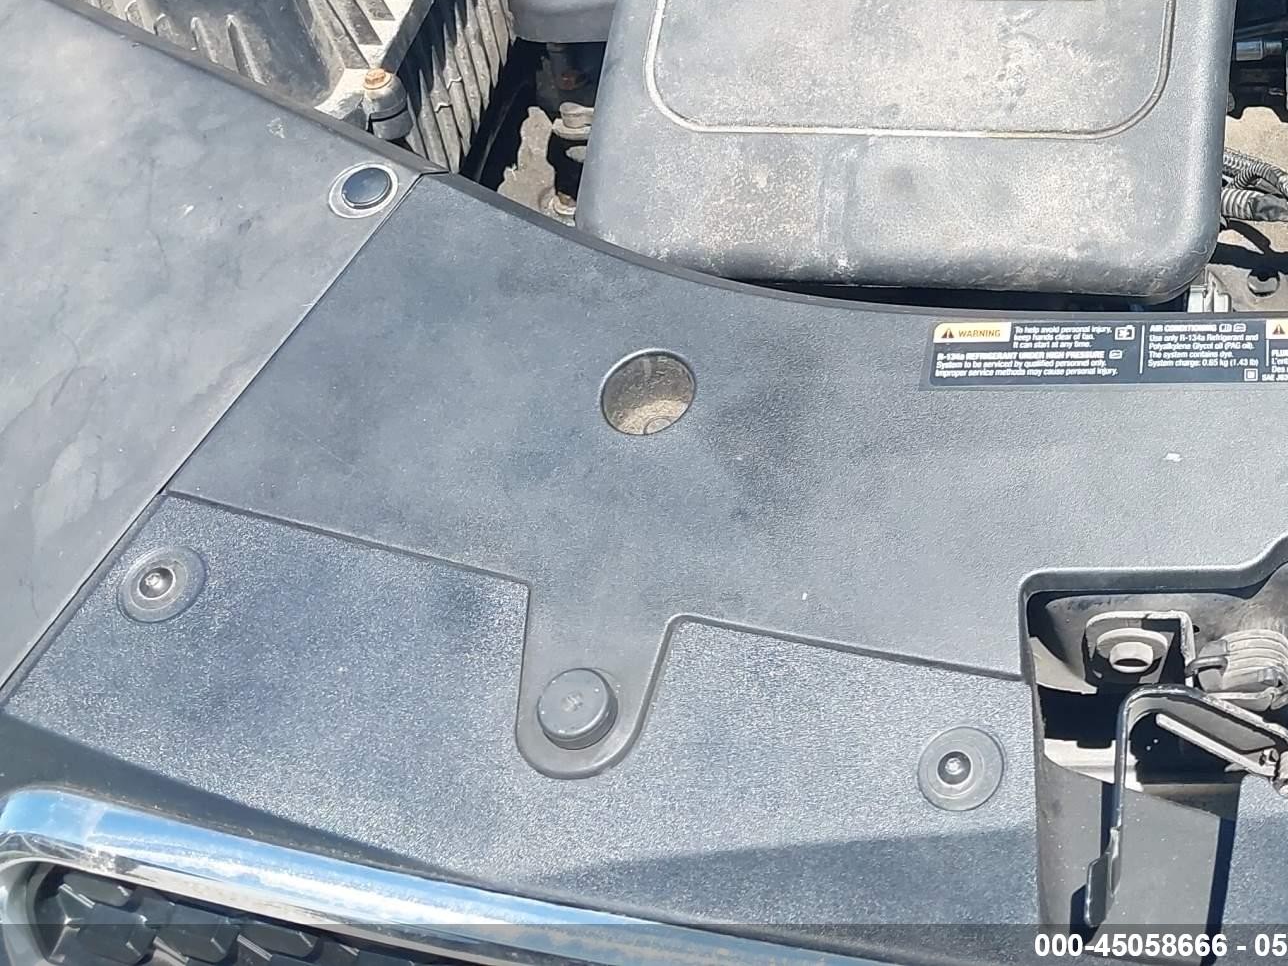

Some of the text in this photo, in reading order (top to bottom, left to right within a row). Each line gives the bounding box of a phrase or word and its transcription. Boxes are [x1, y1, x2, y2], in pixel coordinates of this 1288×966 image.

[958, 329, 1001, 338] WARNING
[1060, 326, 1091, 334] personal
[1163, 334, 1179, 343] only
[1245, 333, 1259, 341] and
[1059, 341, 1073, 349] any
[1192, 342, 1213, 351] Glycol
[1162, 351, 1188, 359] system
[1188, 350, 1218, 358] contains
[936, 361, 963, 370] System
[982, 360, 1013, 368] serviced
[1148, 359, 1174, 368] System
[1219, 358, 1229, 367] kg
[935, 369, 967, 378] Improper
[995, 368, 1026, 376] methods
[1026, 369, 1042, 377] may
[1065, 368, 1096, 376] personal
